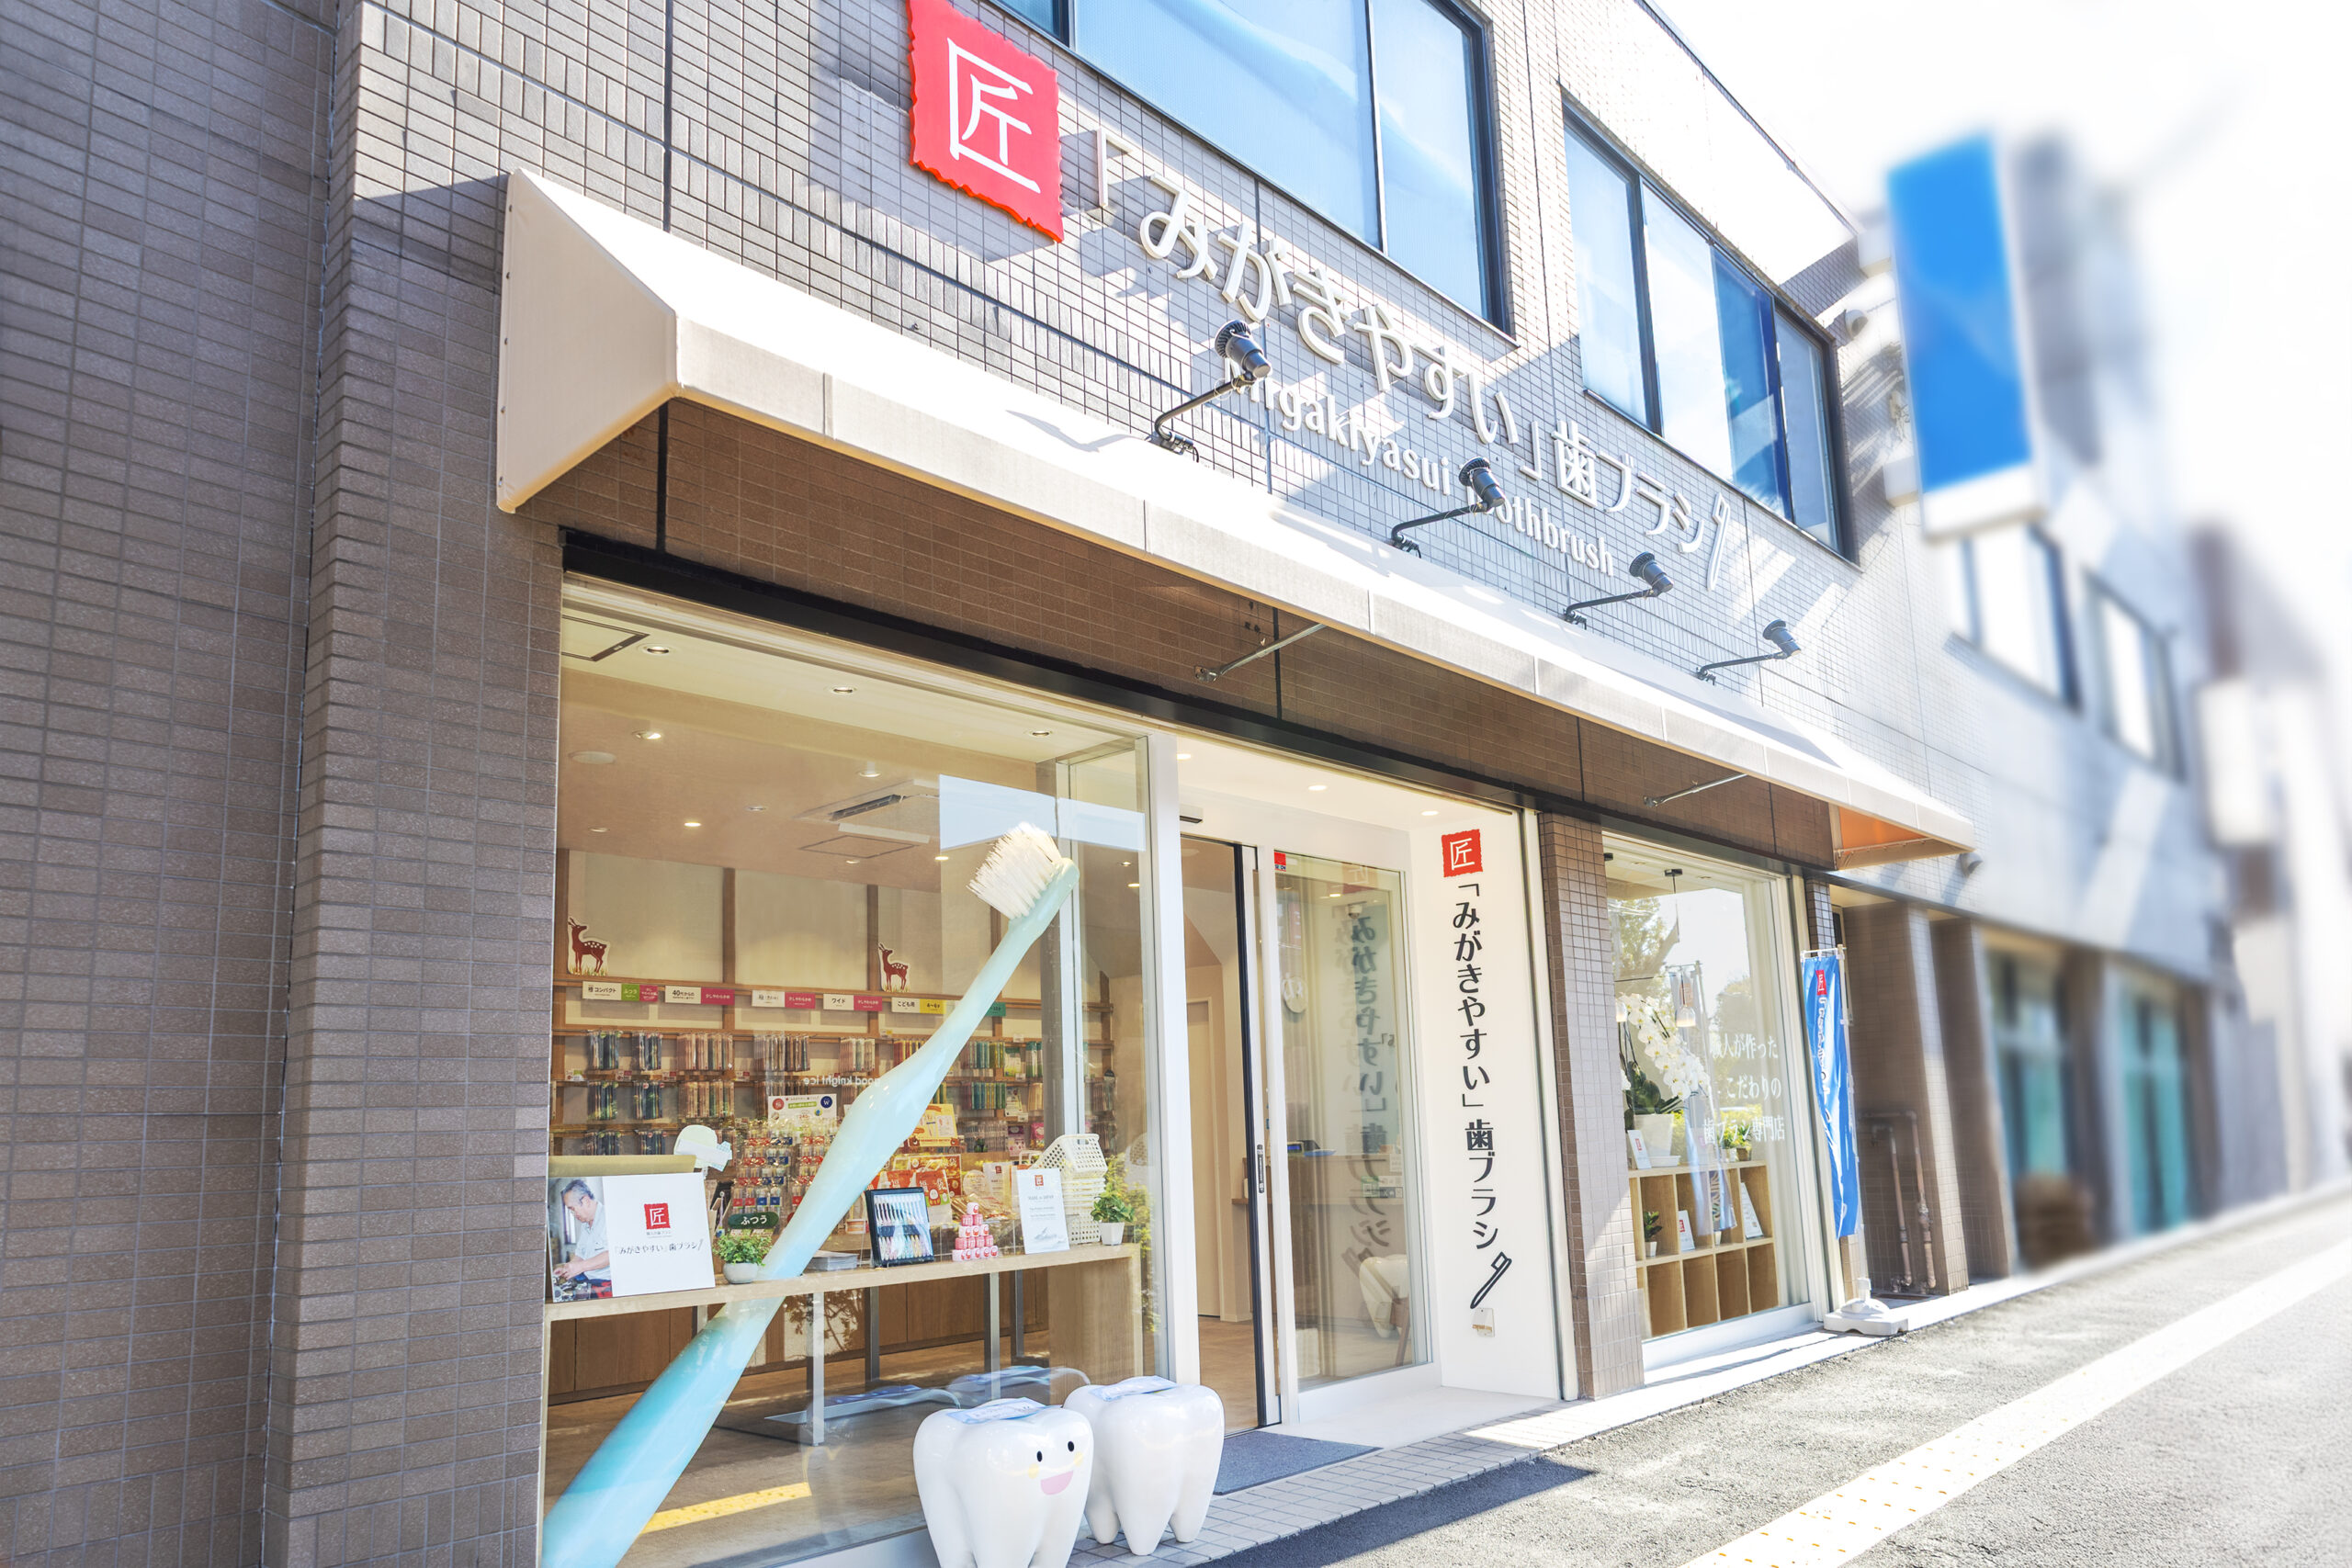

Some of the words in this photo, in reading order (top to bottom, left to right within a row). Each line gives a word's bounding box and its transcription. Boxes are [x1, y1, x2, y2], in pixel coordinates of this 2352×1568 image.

[947, 38, 1041, 194] 匠
[1460, 465, 1614, 577] othbrush
[1450, 837, 1476, 871] 匠
[1452, 883, 1499, 1250] 「みがきやすい」歯ブラシ
[1727, 1074, 1781, 1100] こだわりの
[1702, 1115, 1785, 1145] 歯ブラシ専門店
[650, 1208, 667, 1226] 匠
[741, 1215, 767, 1225] ふつう
